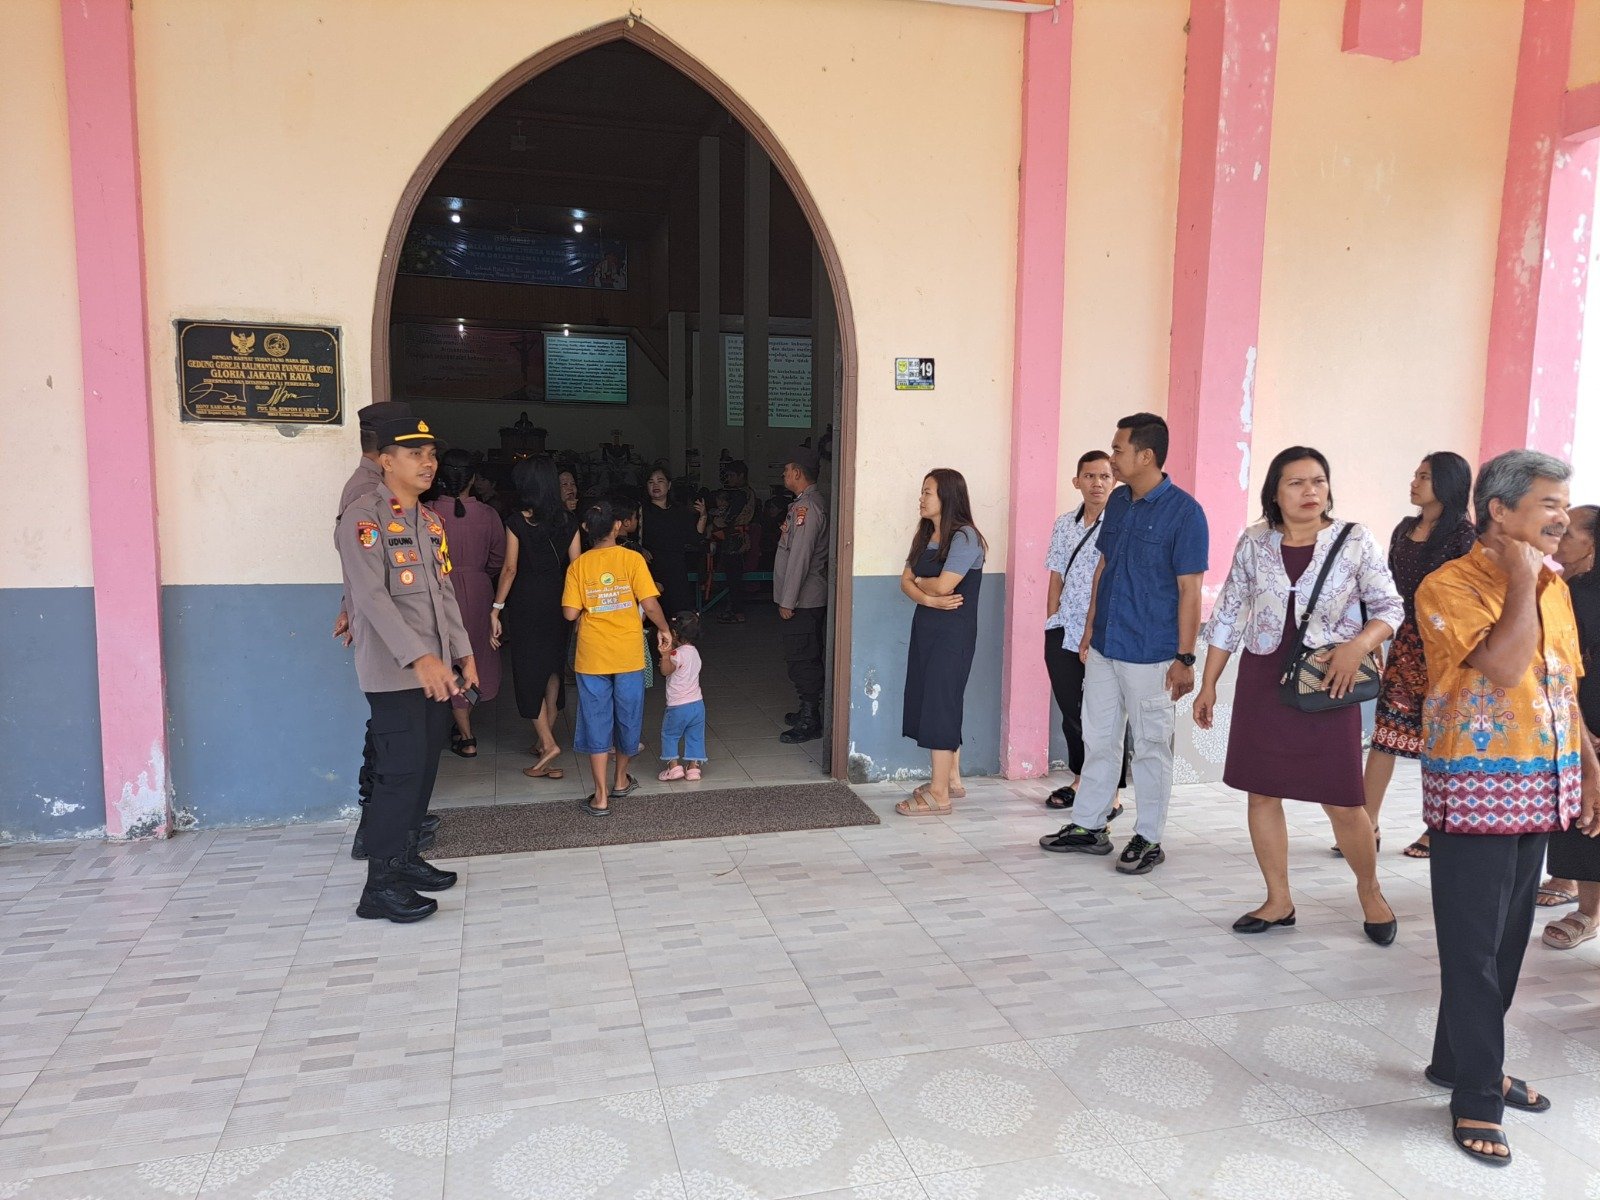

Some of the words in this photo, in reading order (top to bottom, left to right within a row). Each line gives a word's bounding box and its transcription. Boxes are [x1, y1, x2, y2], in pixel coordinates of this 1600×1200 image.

[187, 359, 215, 369] GEDUNG
[215, 360, 240, 369] GEREJA
[242, 361, 280, 371] KALIMANTAN
[281, 363, 315, 373] EVANGELIS
[316, 366, 333, 374] (GKE)
[920, 361, 933, 377] 19
[210, 369, 245, 379] GLORIA
[247, 370, 287, 380] JAKATAN
[289, 371, 312, 381] RAYA
[388, 537, 413, 547] UDUNG
[430, 537, 440, 545] POL
